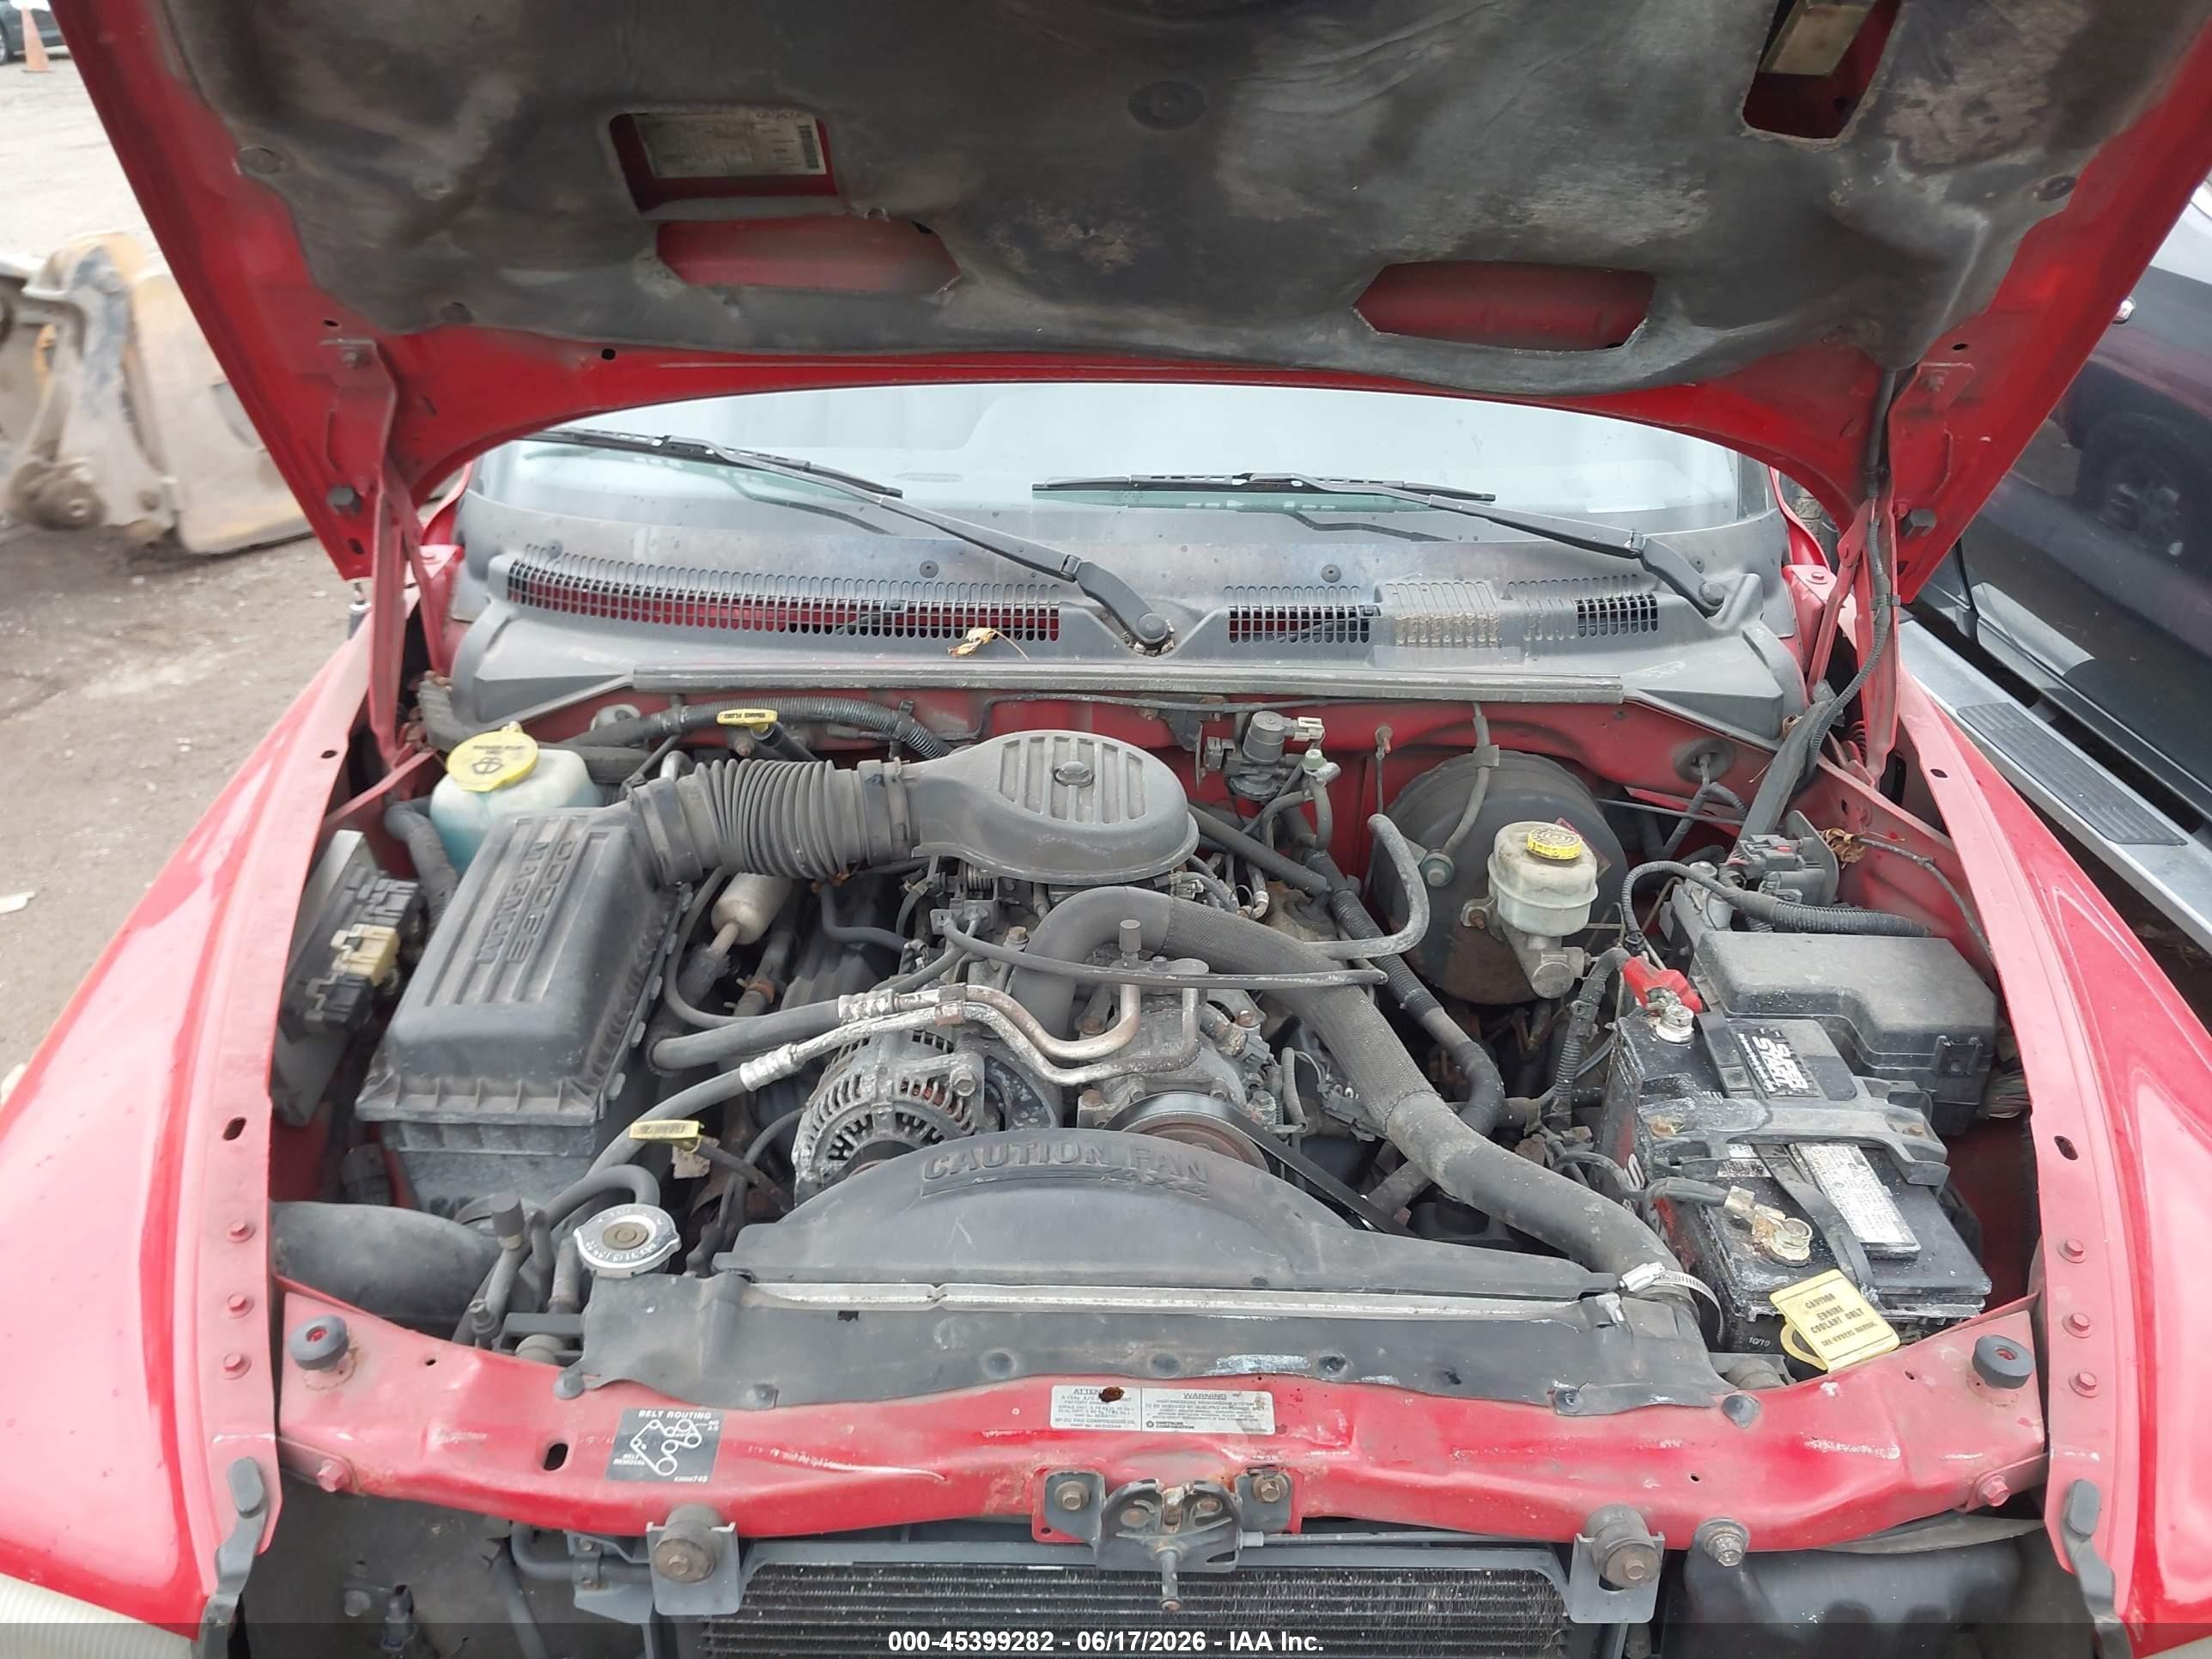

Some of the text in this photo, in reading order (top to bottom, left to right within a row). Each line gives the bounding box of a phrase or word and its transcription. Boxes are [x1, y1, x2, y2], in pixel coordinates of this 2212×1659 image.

[475, 841, 550, 963] MAGNUM
[507, 840, 577, 963] DODGE
[1751, 1036, 1789, 1087] START
[1774, 1042, 1810, 1091] SUPER
[921, 1140, 1209, 1184] CAUTION FAN
[1804, 1292, 1837, 1310] CAUTION
[1816, 1304, 1845, 1321] ENGINE
[1810, 1308, 1864, 1334] COOLANT ONLY
[1748, 1337, 1771, 1347] 10/19
[1182, 1392, 1228, 1401] WARNING
[638, 1410, 712, 1419] BELT ROUTING
